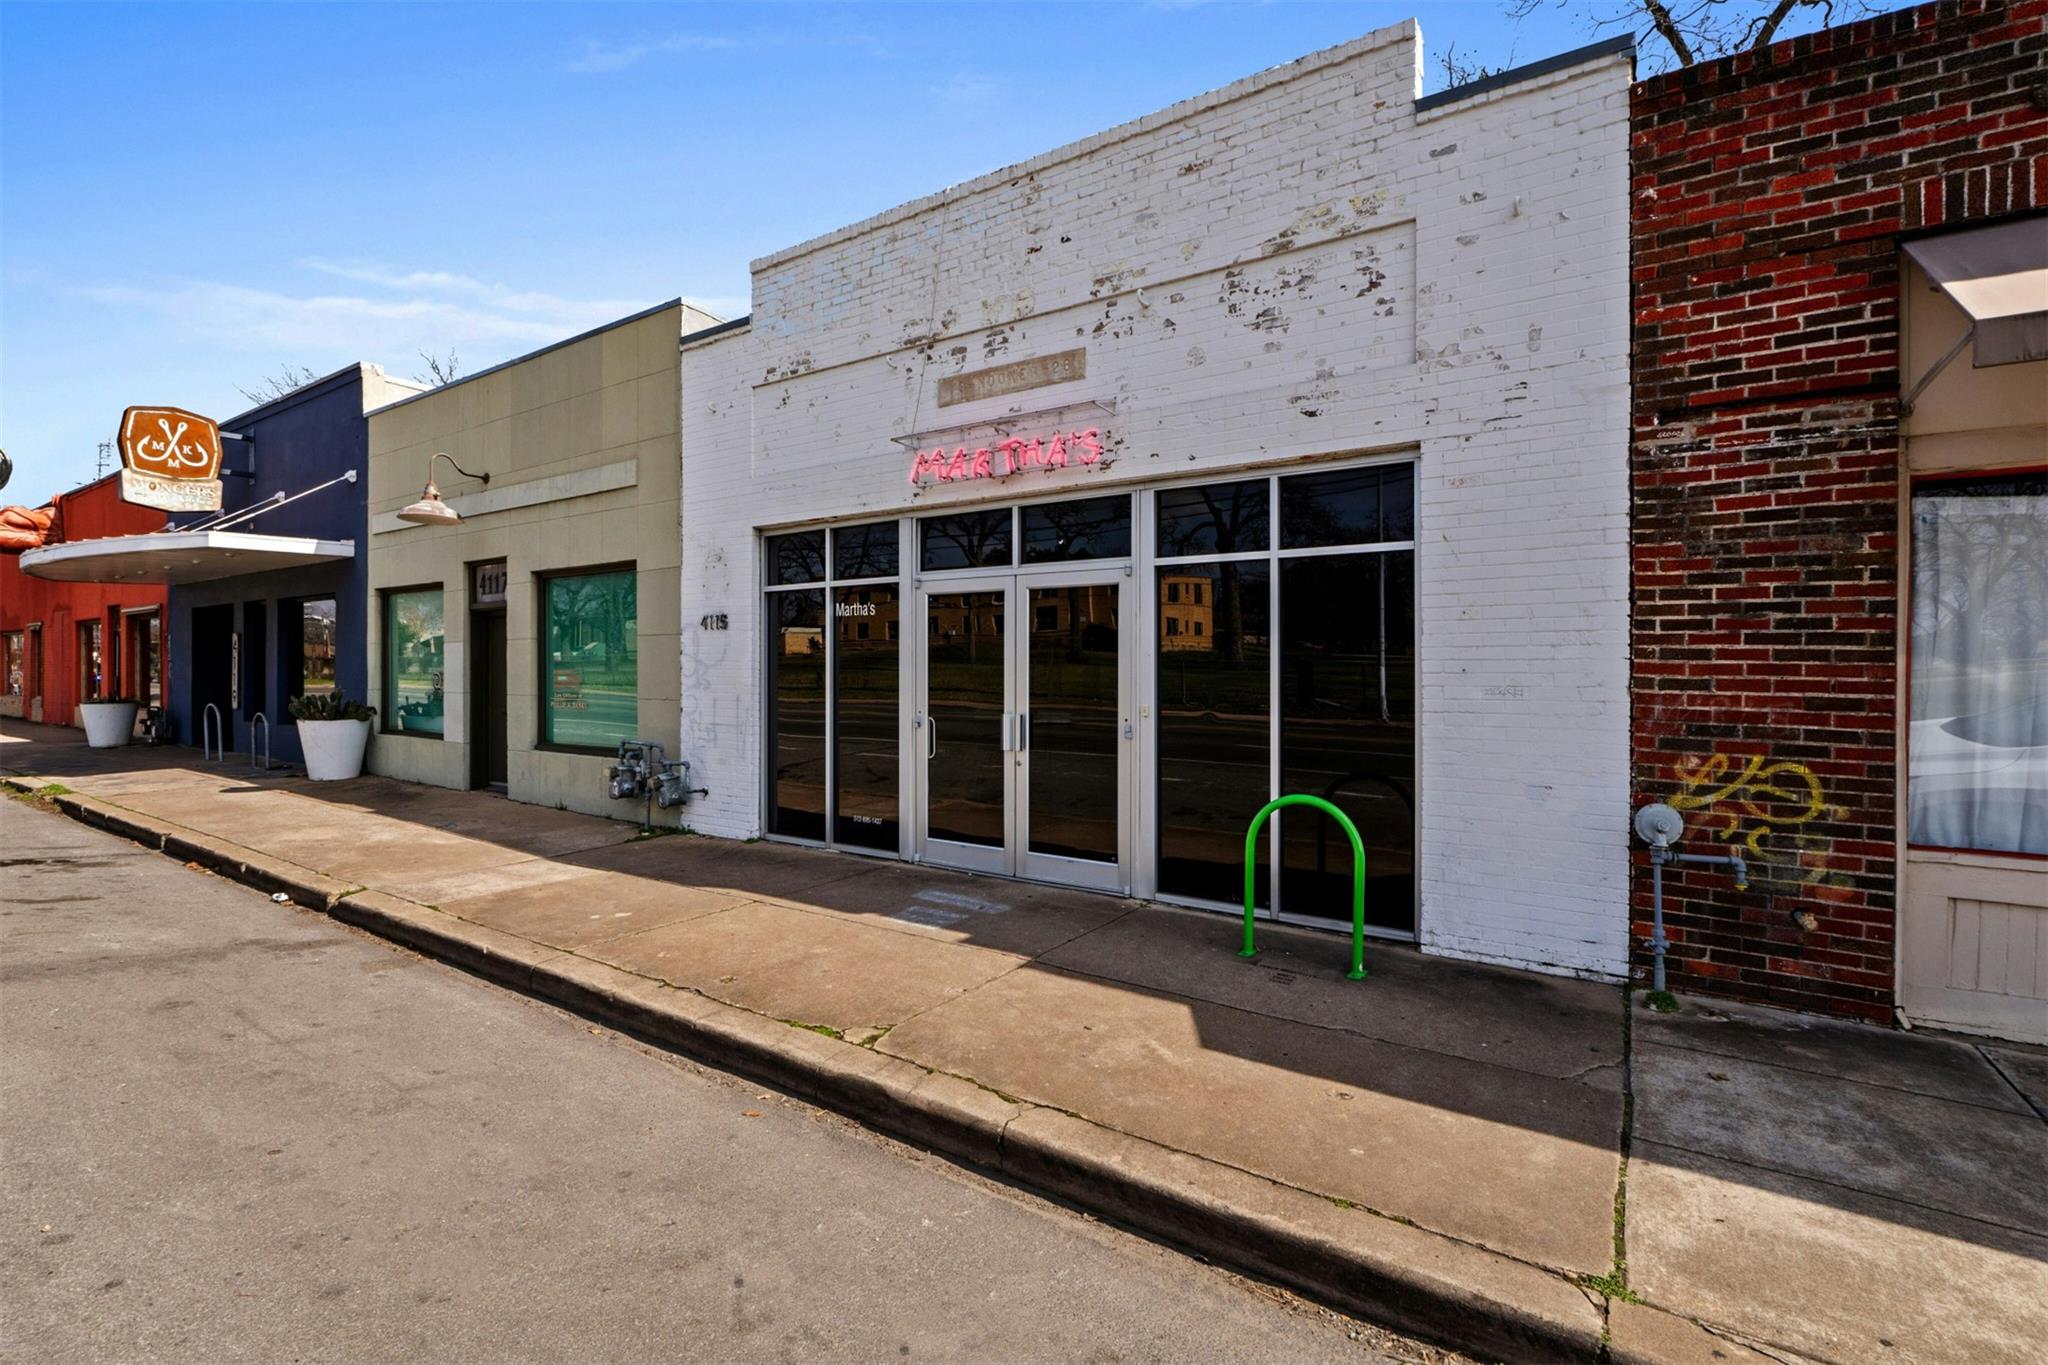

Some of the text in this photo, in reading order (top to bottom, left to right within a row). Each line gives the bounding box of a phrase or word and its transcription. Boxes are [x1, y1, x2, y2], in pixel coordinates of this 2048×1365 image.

[910, 428, 1105, 484] MARTHA'S
[835, 601, 876, 617] Martha's
[700, 613, 729, 631] 4115
